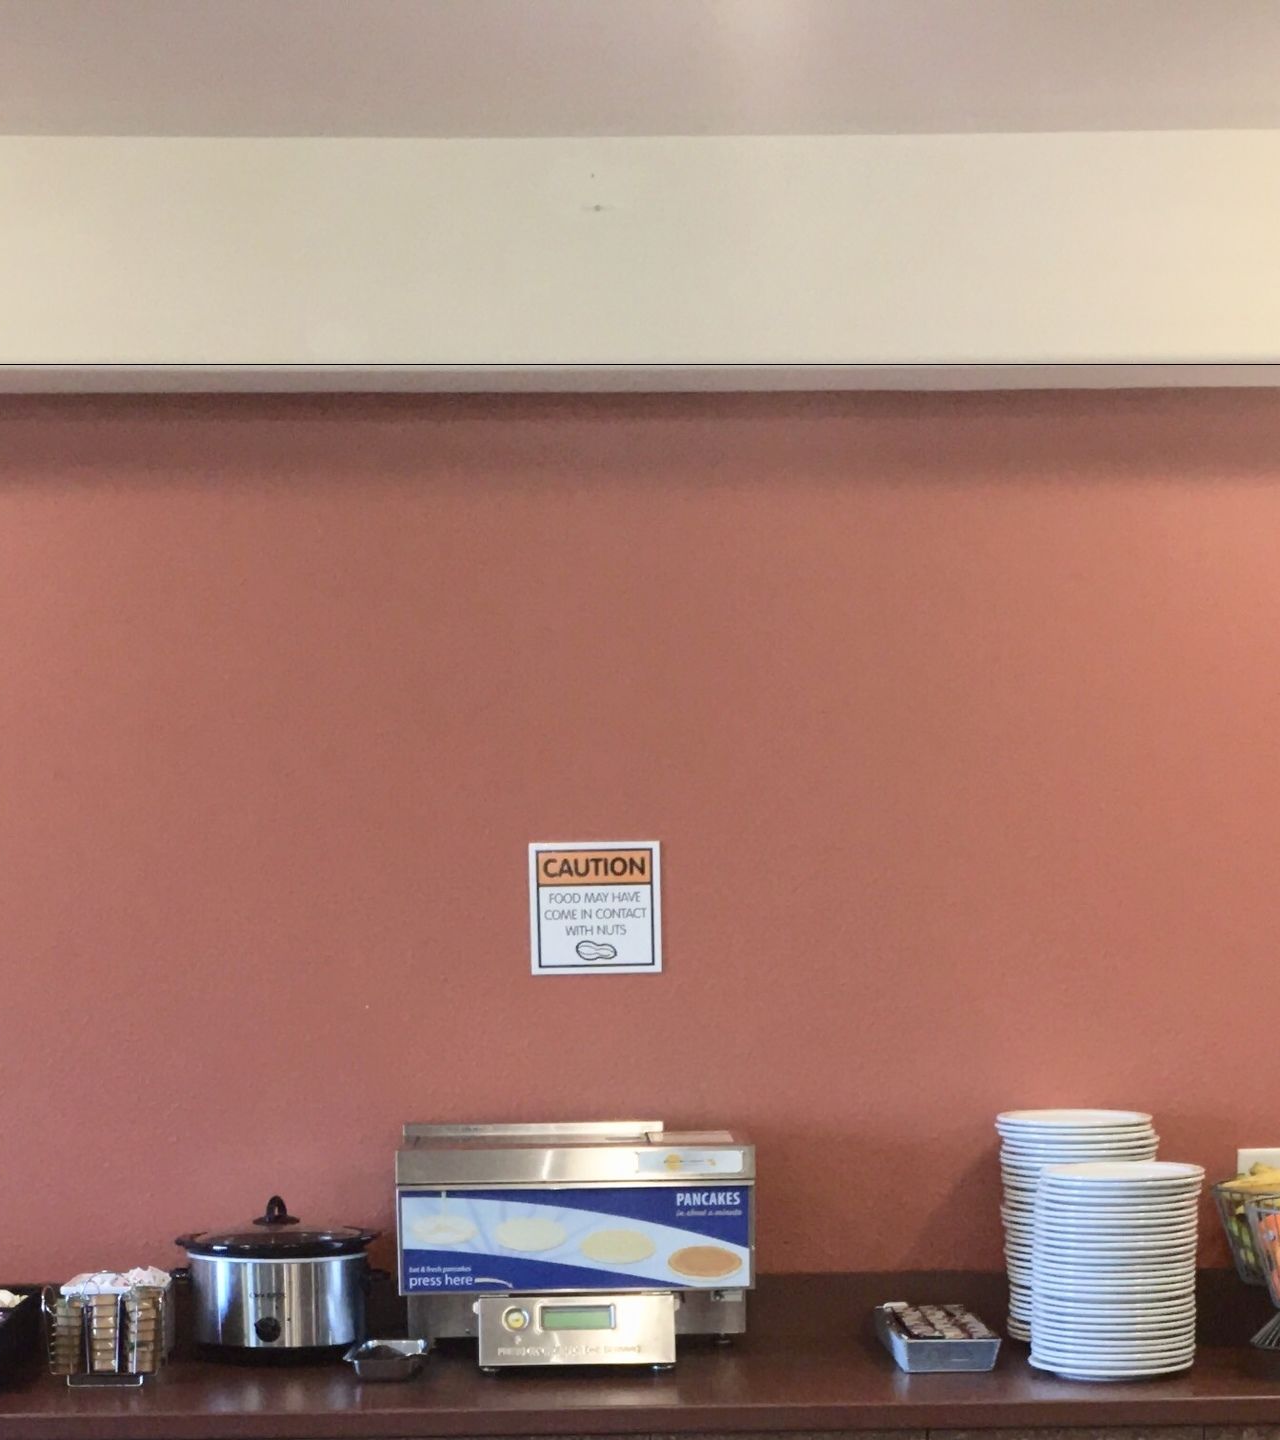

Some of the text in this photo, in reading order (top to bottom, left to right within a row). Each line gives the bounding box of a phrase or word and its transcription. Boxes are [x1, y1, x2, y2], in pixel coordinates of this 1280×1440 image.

[543, 857, 646, 878] CAUTION
[548, 891, 641, 904] FOOD MAY HAVE
[544, 908, 647, 921] COME IN CONTACT
[565, 924, 627, 936] WITH NUTS
[676, 1191, 741, 1206] PANCAKES
[409, 1274, 473, 1289] press here
